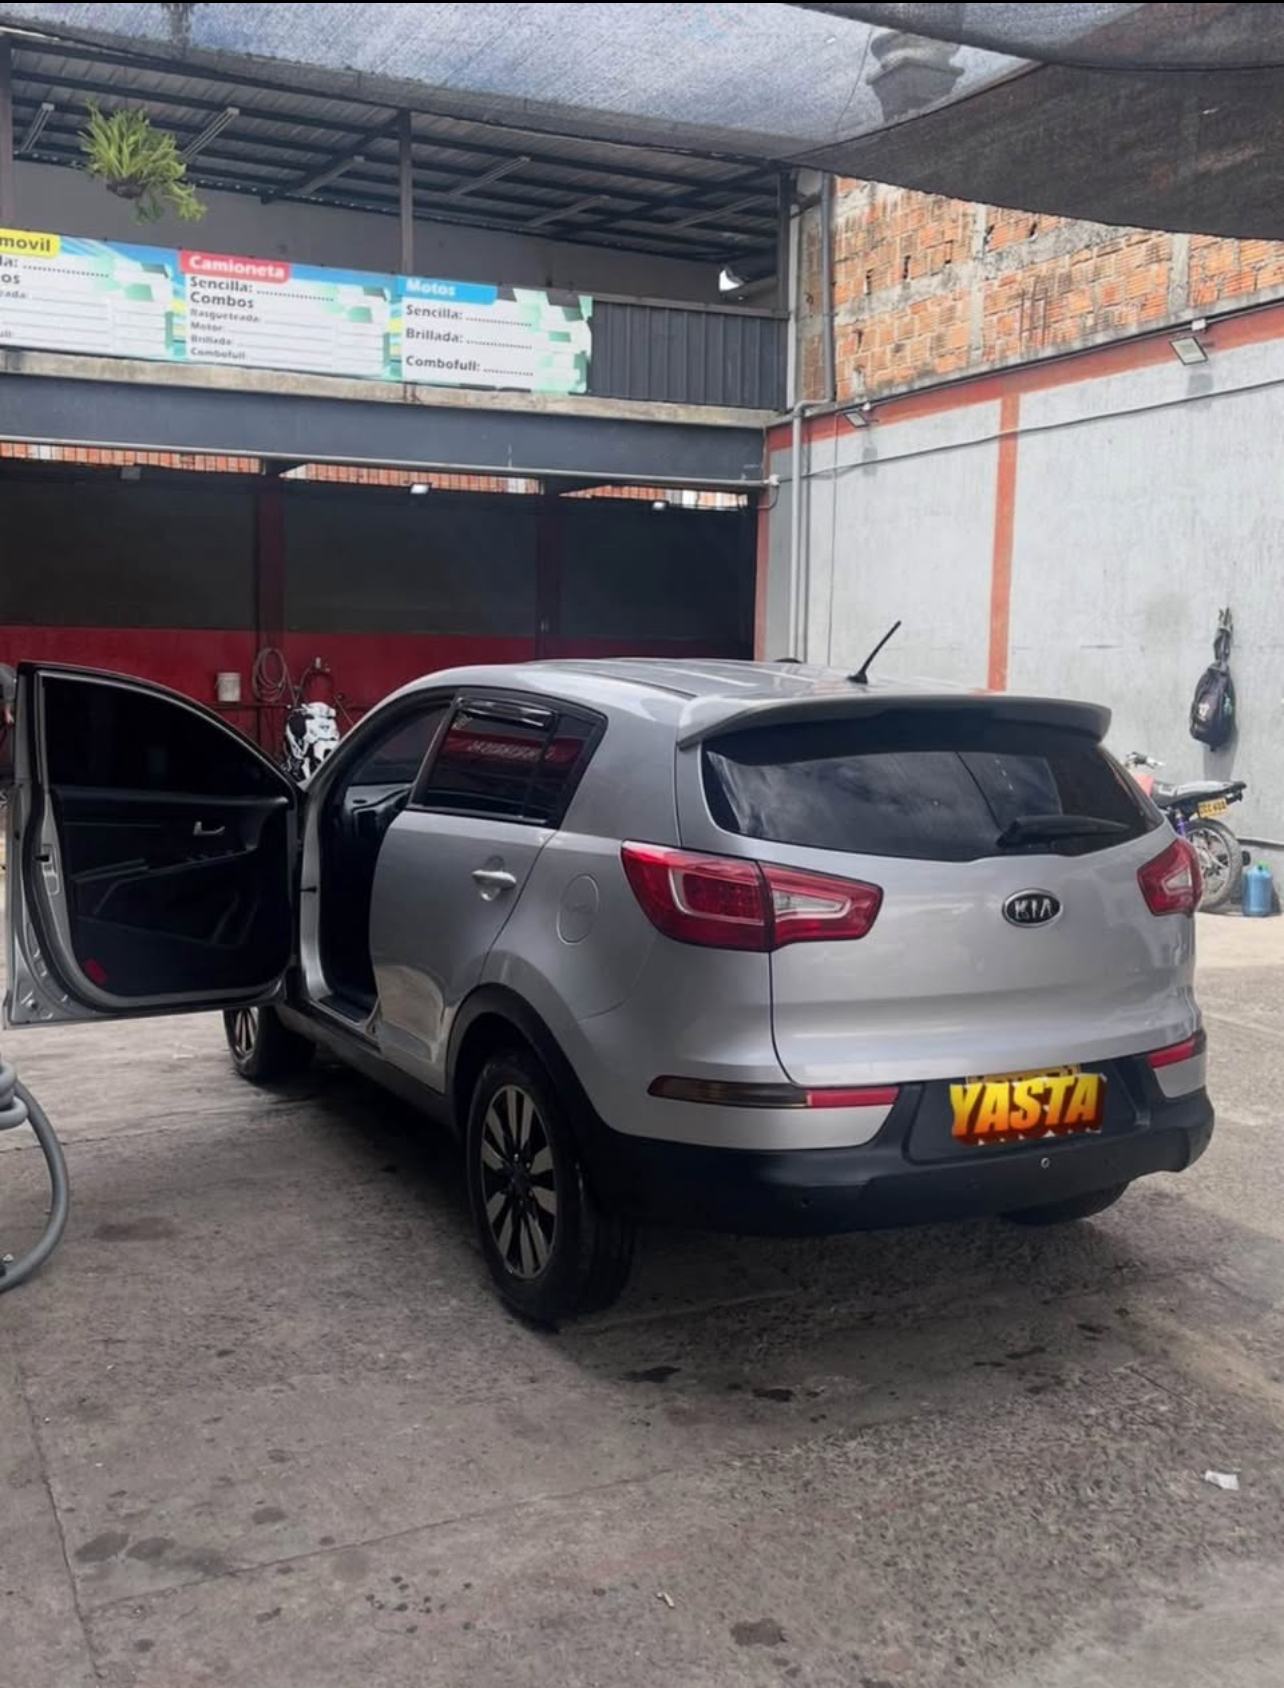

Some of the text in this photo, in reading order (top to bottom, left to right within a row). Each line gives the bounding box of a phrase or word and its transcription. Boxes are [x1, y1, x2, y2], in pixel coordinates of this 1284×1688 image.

[189, 255, 285, 279] Camioneta
[190, 276, 253, 293] Sencilla:
[406, 278, 456, 296] Motos
[190, 291, 254, 308] Combos
[406, 304, 463, 320] Sencilla:
[406, 328, 463, 343] Brillada:
[406, 355, 480, 372] Combofull:
[1014, 897, 1052, 919] KIA
